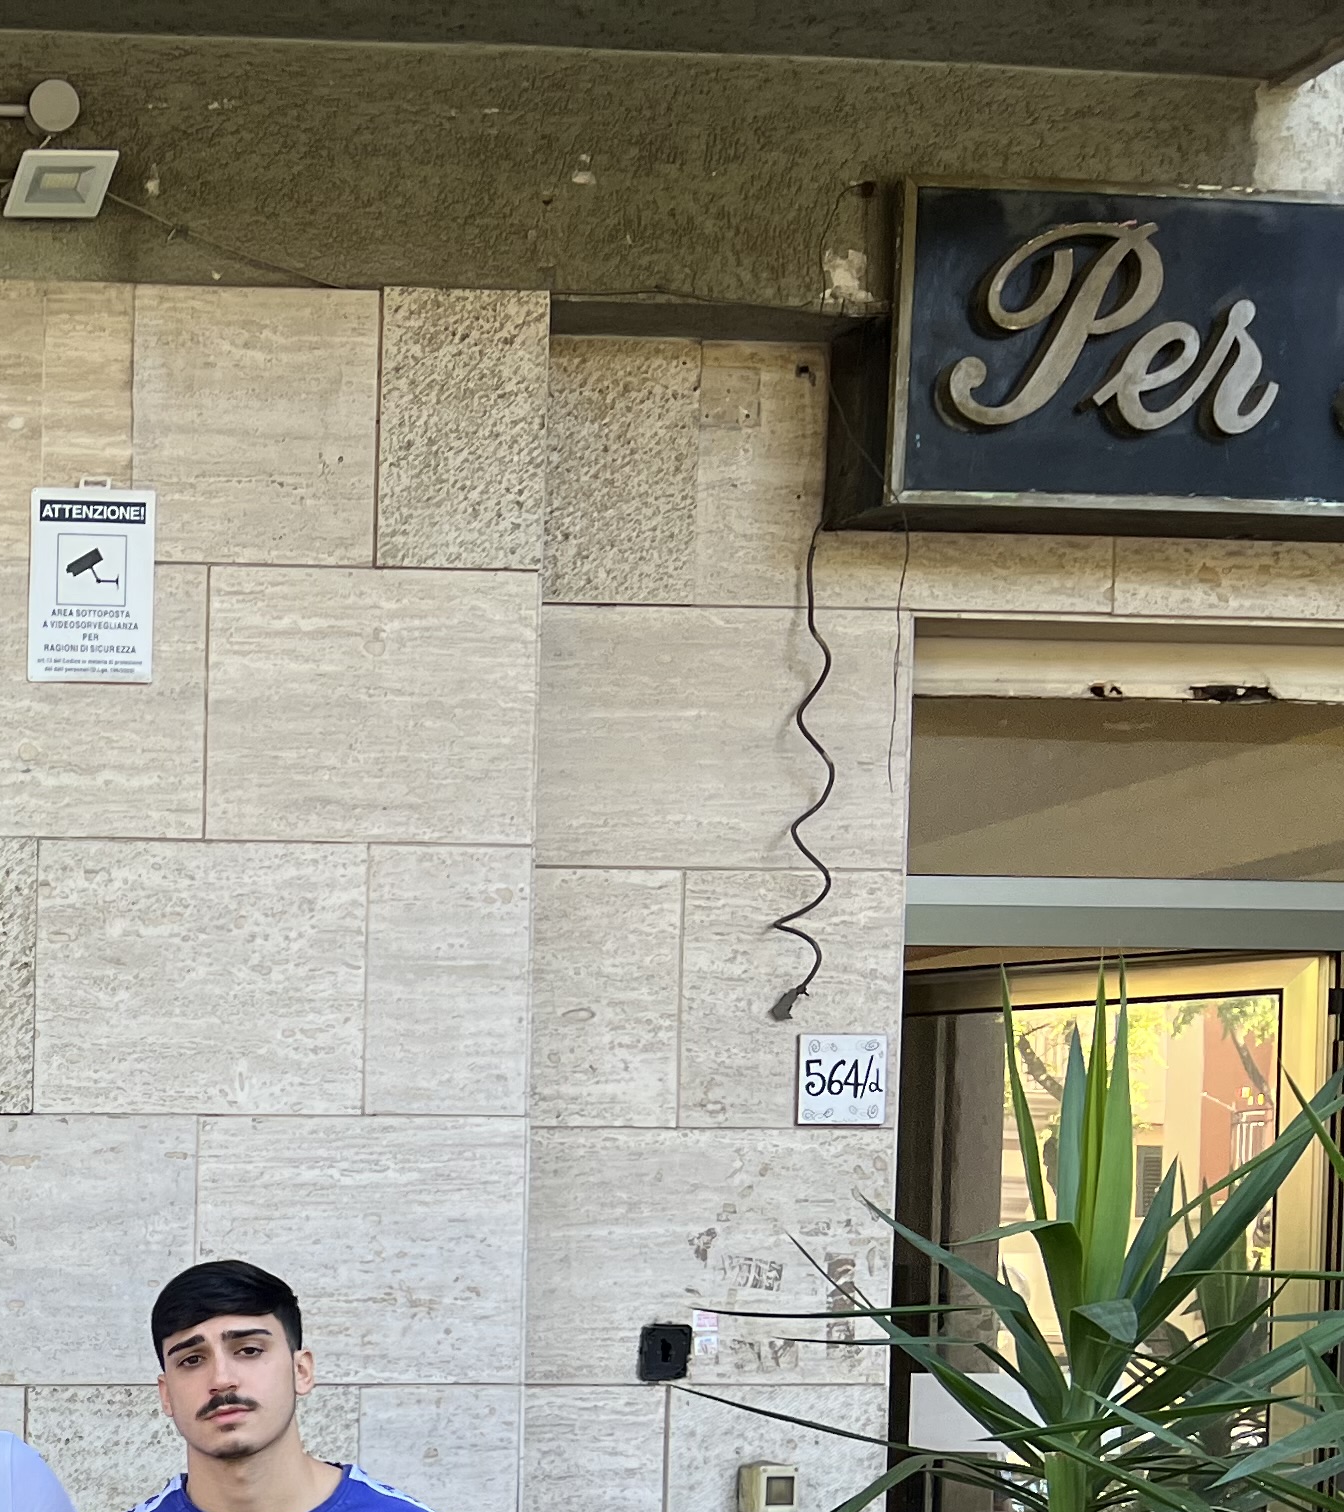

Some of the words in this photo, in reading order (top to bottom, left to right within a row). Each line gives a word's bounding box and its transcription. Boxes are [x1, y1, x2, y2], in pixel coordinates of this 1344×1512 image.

[949, 221, 1280, 435] Per
[41, 504, 145, 521] ATTENZIONE!
[51, 608, 74, 617] AREA
[75, 609, 130, 618] SOTTOPOSTA
[42, 620, 48, 628] A
[50, 621, 139, 630] VIDEOSORVEGLIANZA
[82, 633, 99, 641] PER
[43, 644, 79, 652] RAGIONI
[80, 645, 89, 653] DI
[90, 645, 136, 654] SICUREZZA
